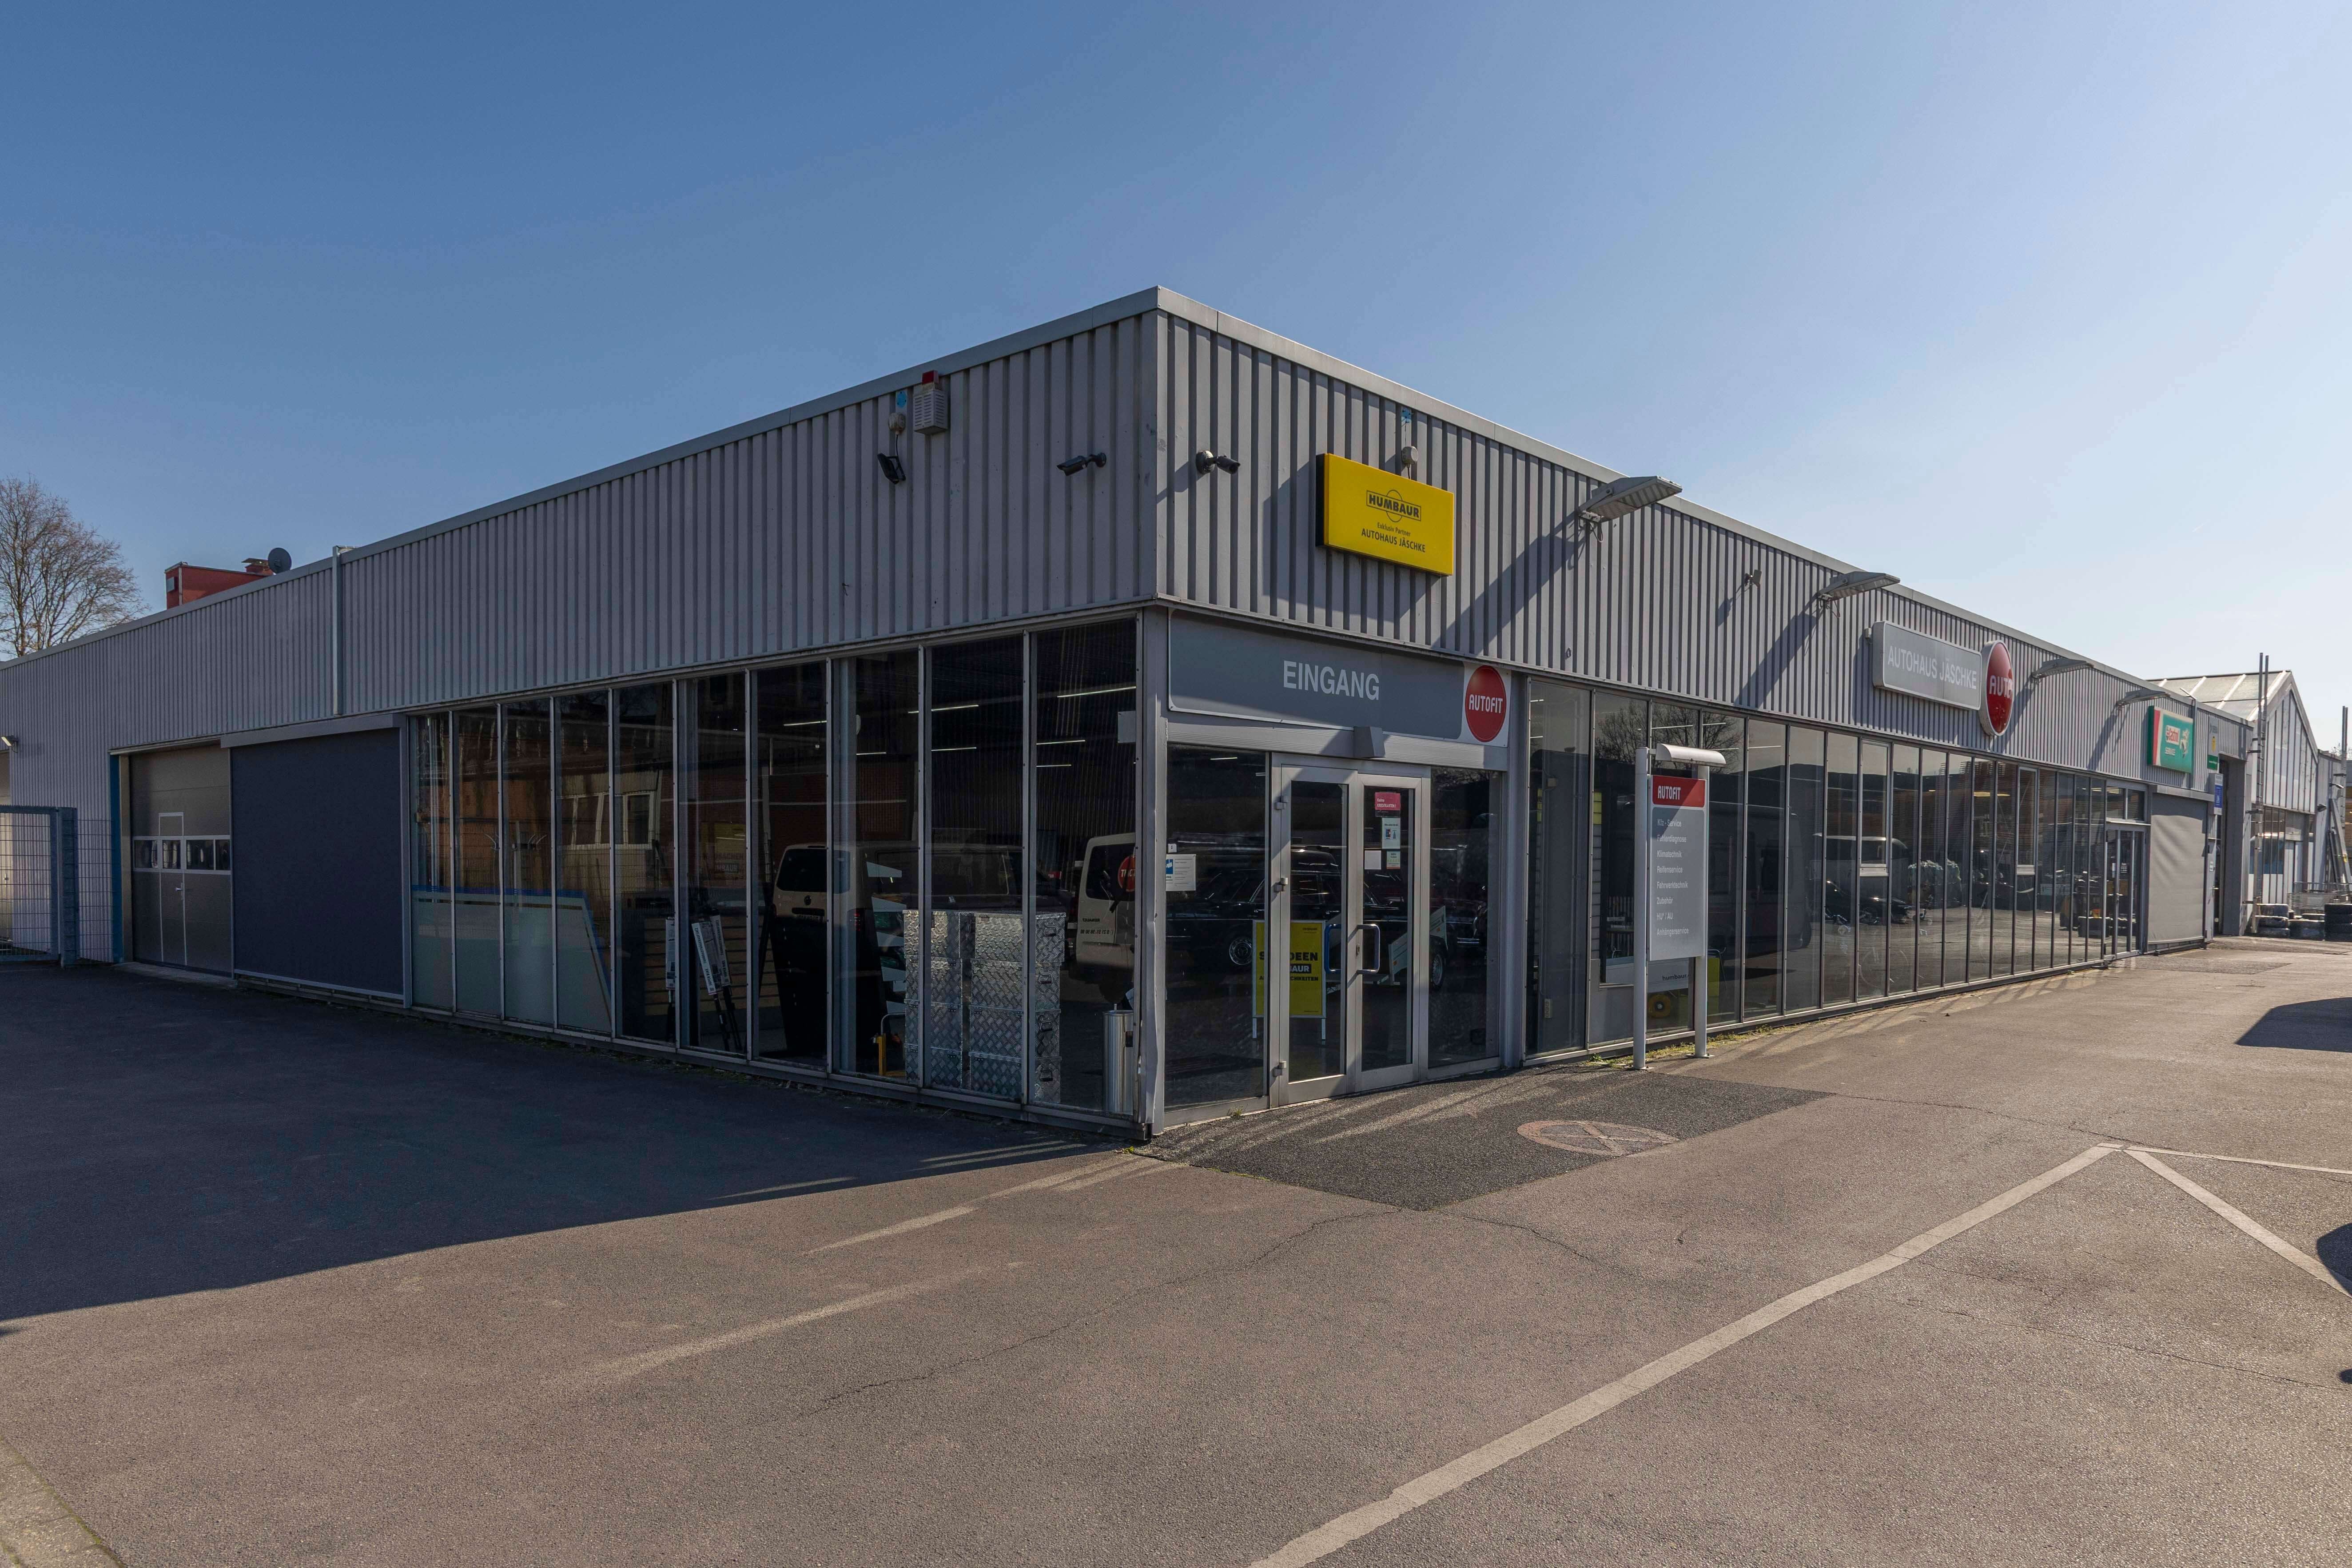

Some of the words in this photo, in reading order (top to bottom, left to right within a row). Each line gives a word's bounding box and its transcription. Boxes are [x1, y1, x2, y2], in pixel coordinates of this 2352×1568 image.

[1369, 494, 1419, 518] HUMBAUR
[1377, 522, 1394, 533] Exklusiv
[1395, 527, 1411, 537] Partner
[1361, 528, 1397, 545] AUTOHAUS
[1399, 536, 1425, 553] JÄSCHKE
[1888, 645, 1937, 679] AUTOHAUS
[1939, 657, 1977, 689] JÄSCHKE
[1283, 660, 1379, 700] EINGANG
[1469, 694, 1503, 714] AUTOFIT
[1658, 785, 1681, 800] AUTOFIT
[1657, 835, 1687, 844] Fehlerdiagnose
[1656, 927, 1688, 937] Anhängerservice
